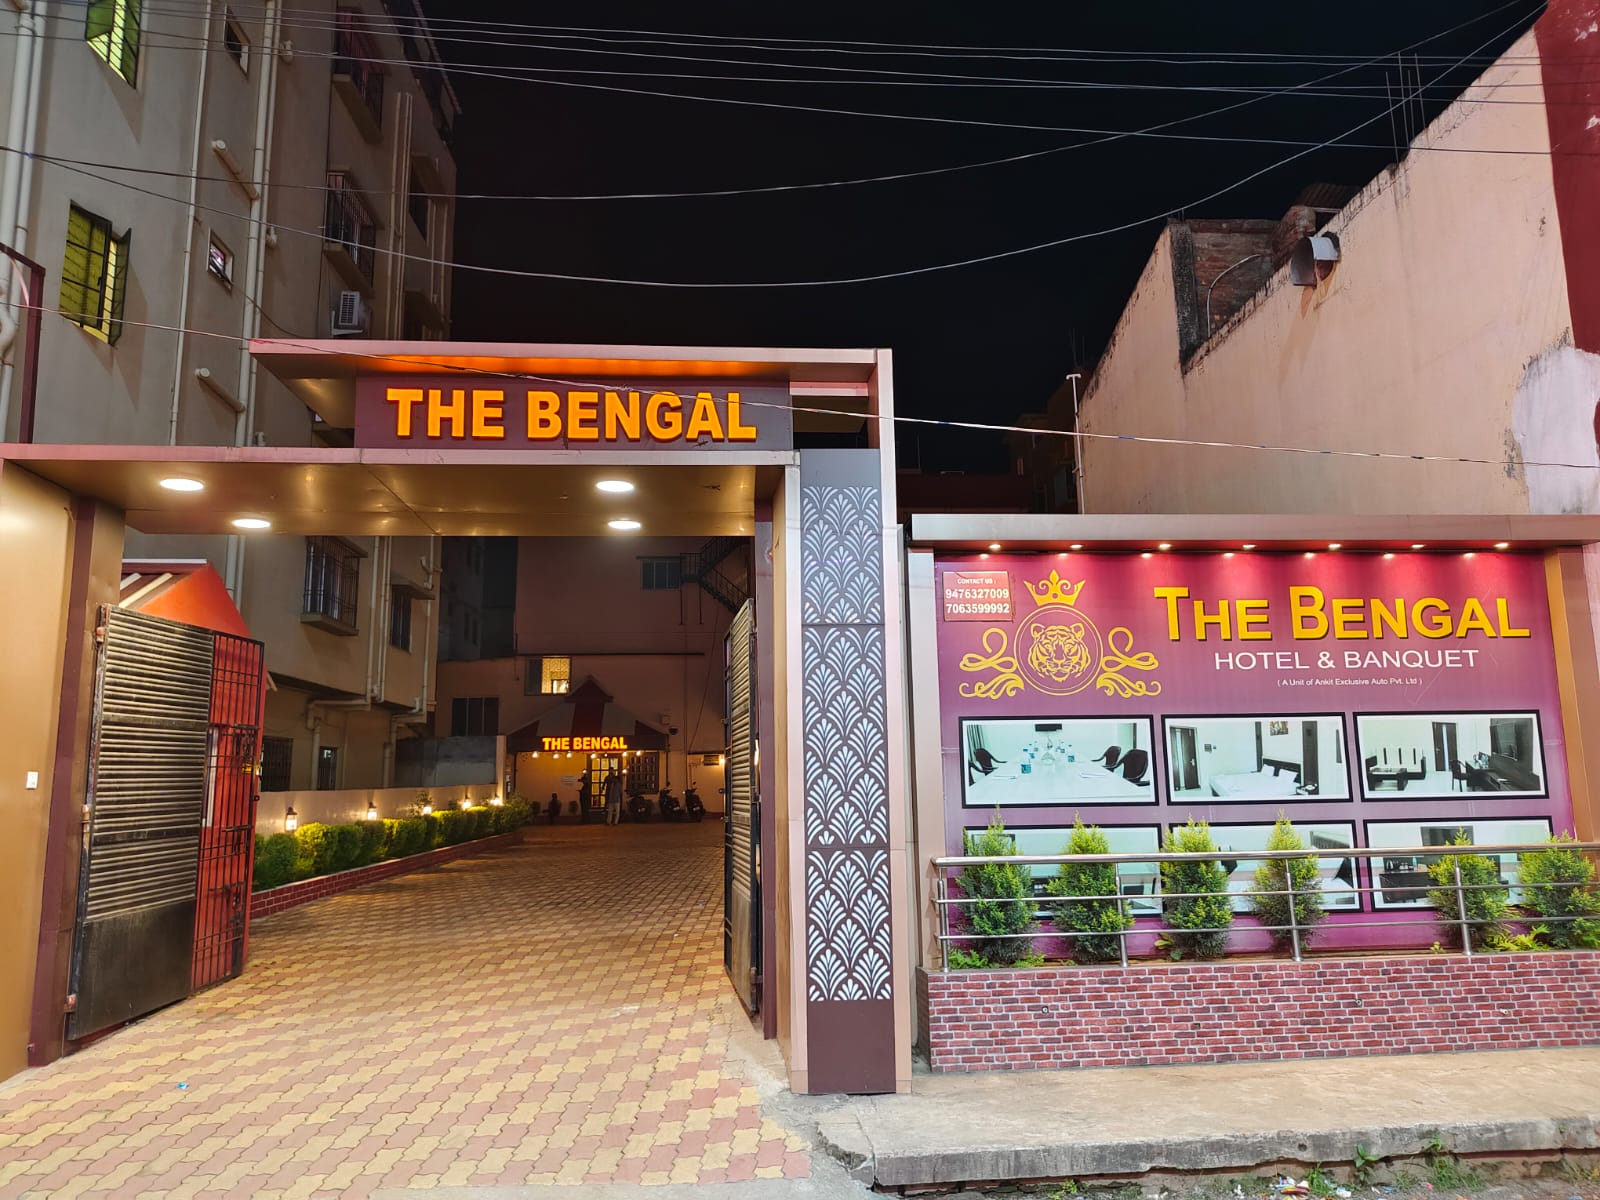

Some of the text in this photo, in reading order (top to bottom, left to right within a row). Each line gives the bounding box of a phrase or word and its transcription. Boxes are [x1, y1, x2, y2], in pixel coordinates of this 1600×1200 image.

[386, 388, 758, 442] THE BENGAL
[945, 588, 1010, 599] 9476327009
[945, 603, 1010, 614] 7063599992
[1154, 585, 1532, 641] THE BENGAL
[1214, 649, 1479, 670] HOTEL & BANQUET
[1306, 678, 1314, 686] of
[1315, 678, 1334, 686] Ankit
[1335, 677, 1370, 686] Exclusive
[1371, 677, 1388, 685] Auto
[542, 736, 628, 751] THE BENGAL
